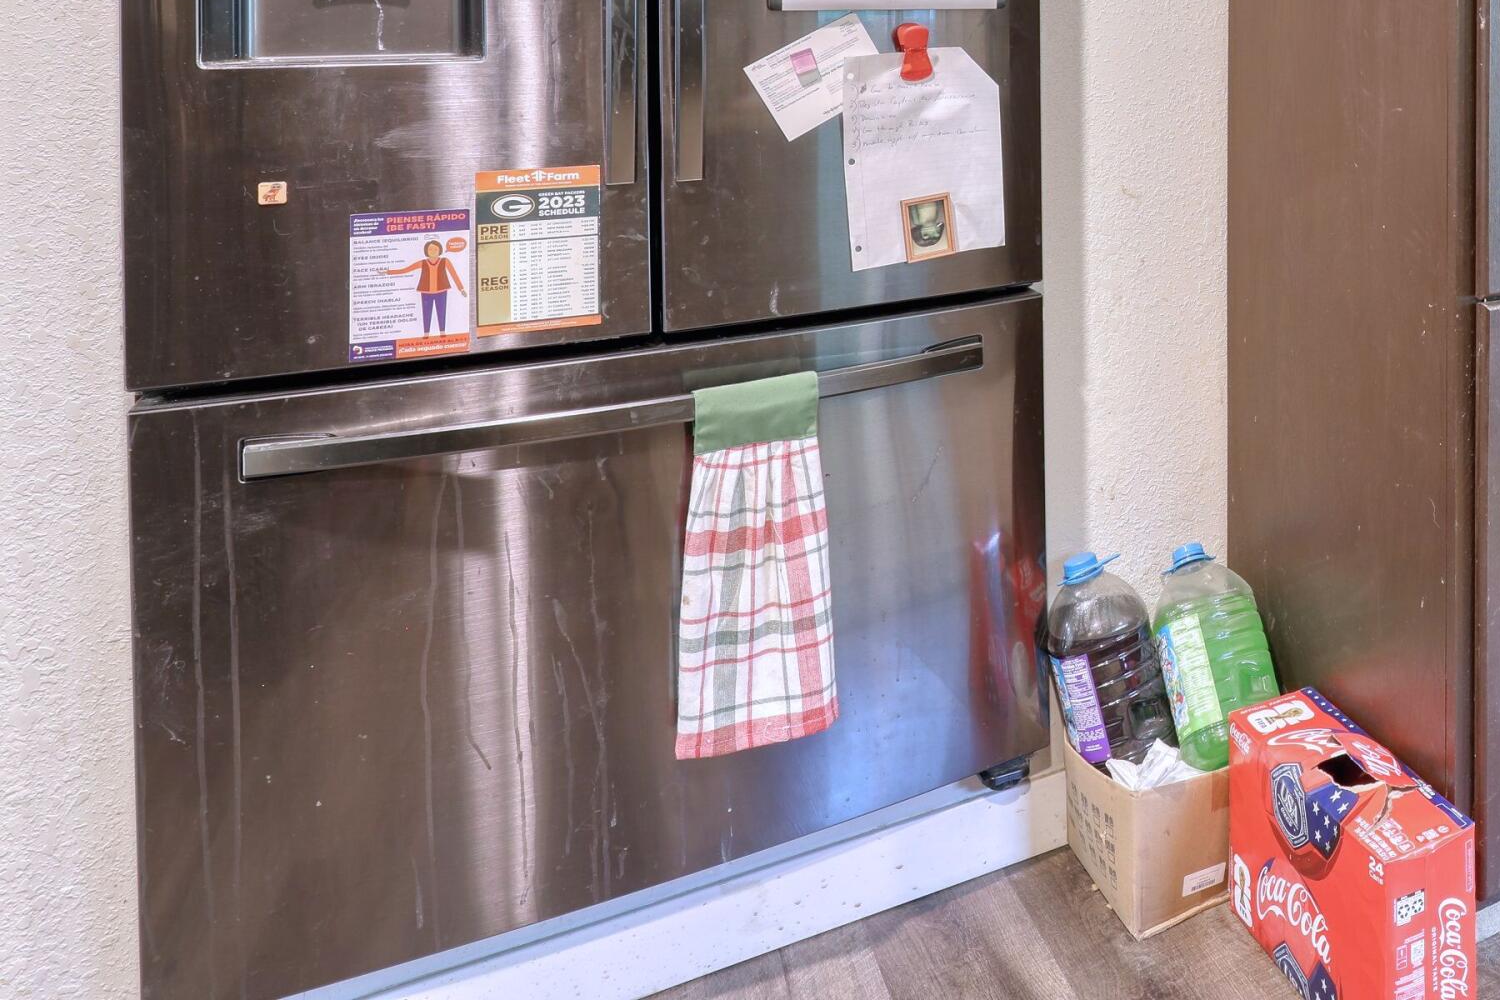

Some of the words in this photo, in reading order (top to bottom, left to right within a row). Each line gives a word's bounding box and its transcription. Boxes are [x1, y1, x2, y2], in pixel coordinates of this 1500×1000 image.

[496, 174, 531, 184] Fleet
[547, 171, 580, 181] Farm
[538, 194, 585, 210] 2023
[538, 207, 585, 217] SCHEDULE
[386, 215, 424, 224] PIENSE
[426, 213, 466, 222] RÁPIDO
[386, 223, 404, 233] (BE
[406, 221, 436, 231] FAST)
[480, 224, 509, 235] PRE
[480, 233, 508, 241] SEASON
[480, 276, 509, 287] REG
[481, 284, 509, 292] SEASON
[1368, 855, 1385, 877] 24
[1256, 865, 1331, 965] Coca-Cola
